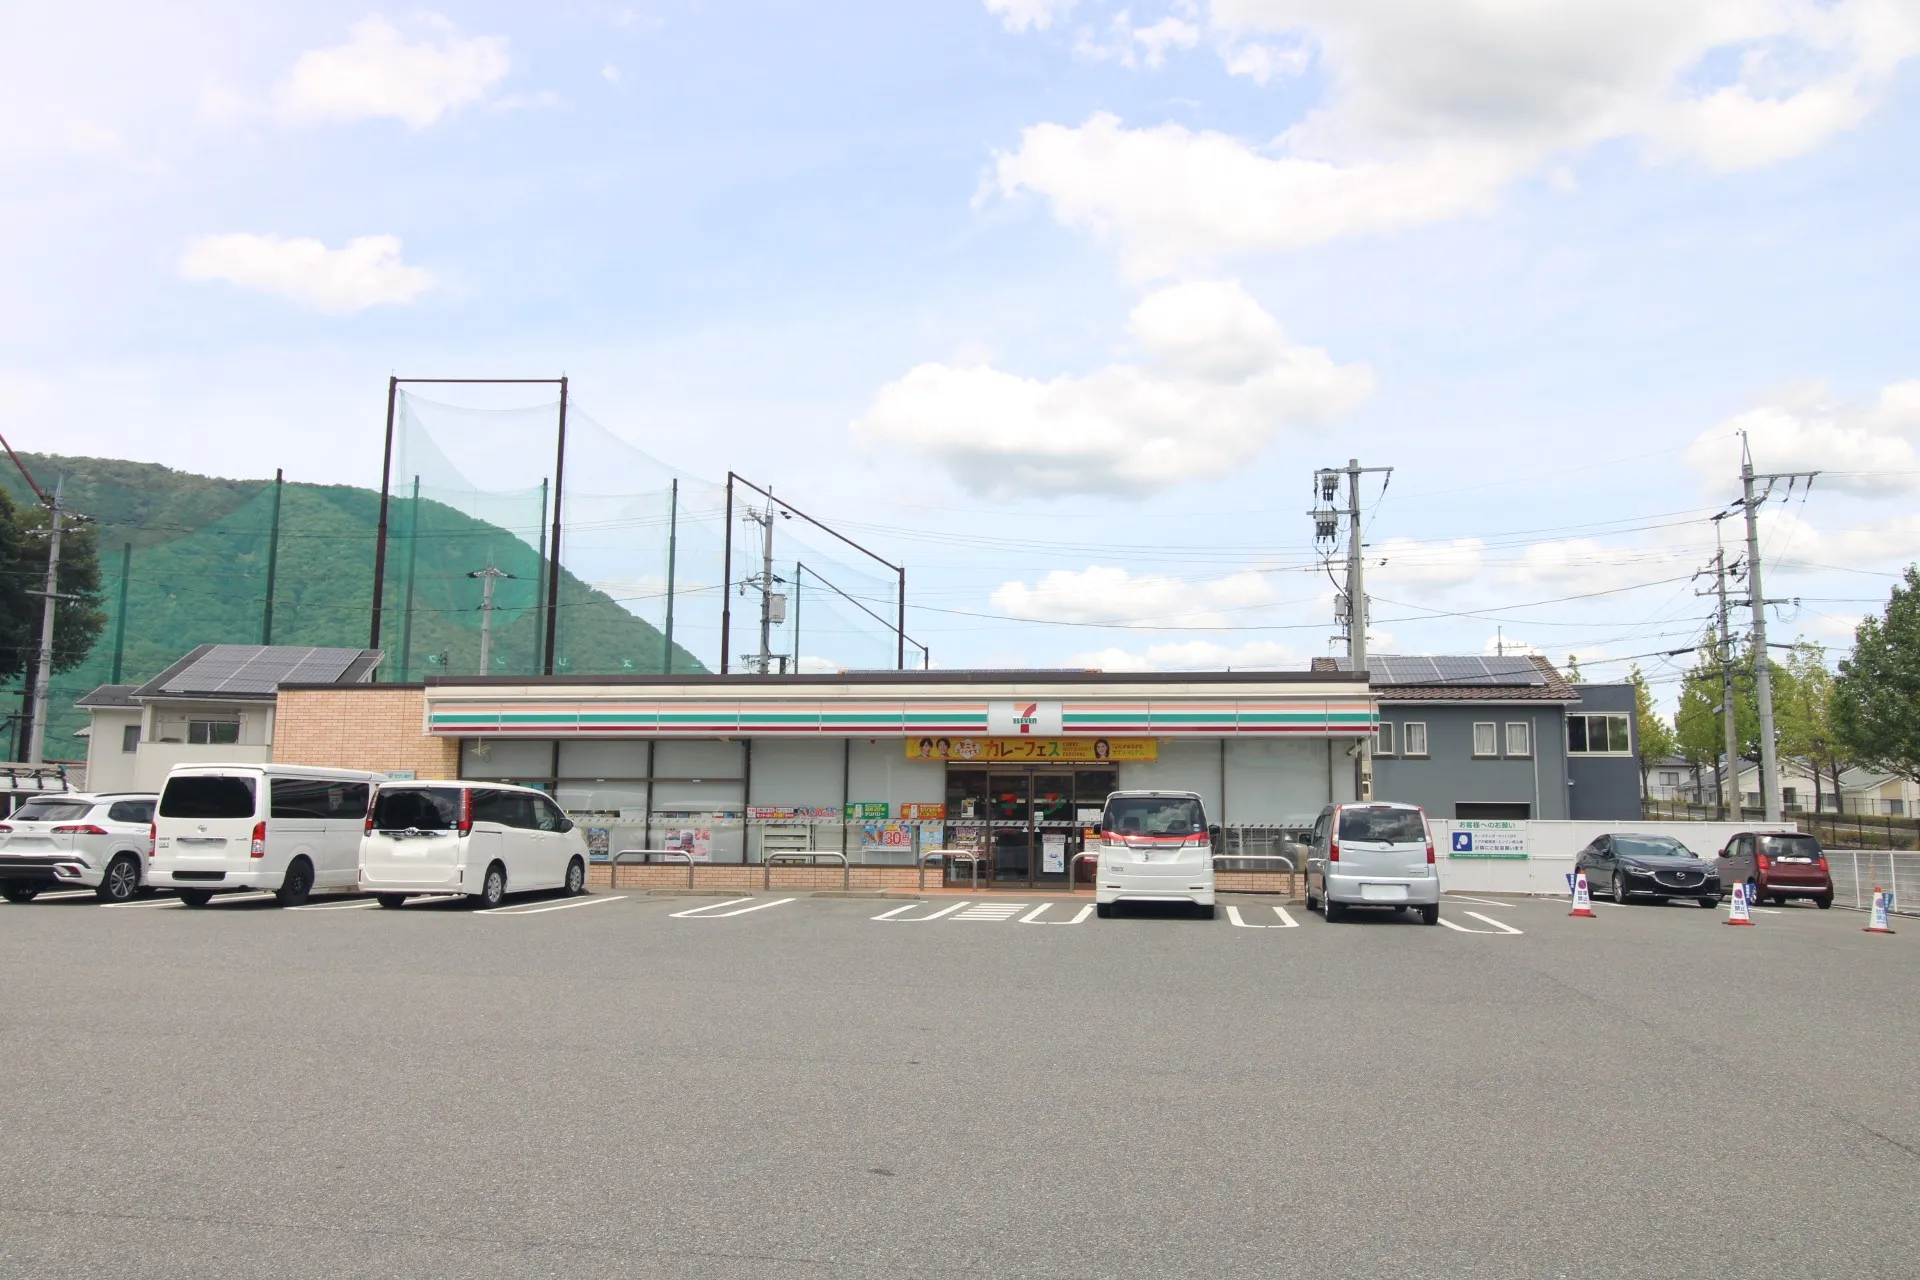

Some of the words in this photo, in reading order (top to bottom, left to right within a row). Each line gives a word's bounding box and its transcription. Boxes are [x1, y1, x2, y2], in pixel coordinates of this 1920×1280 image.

[984, 740, 1060, 757] カレーフェス
